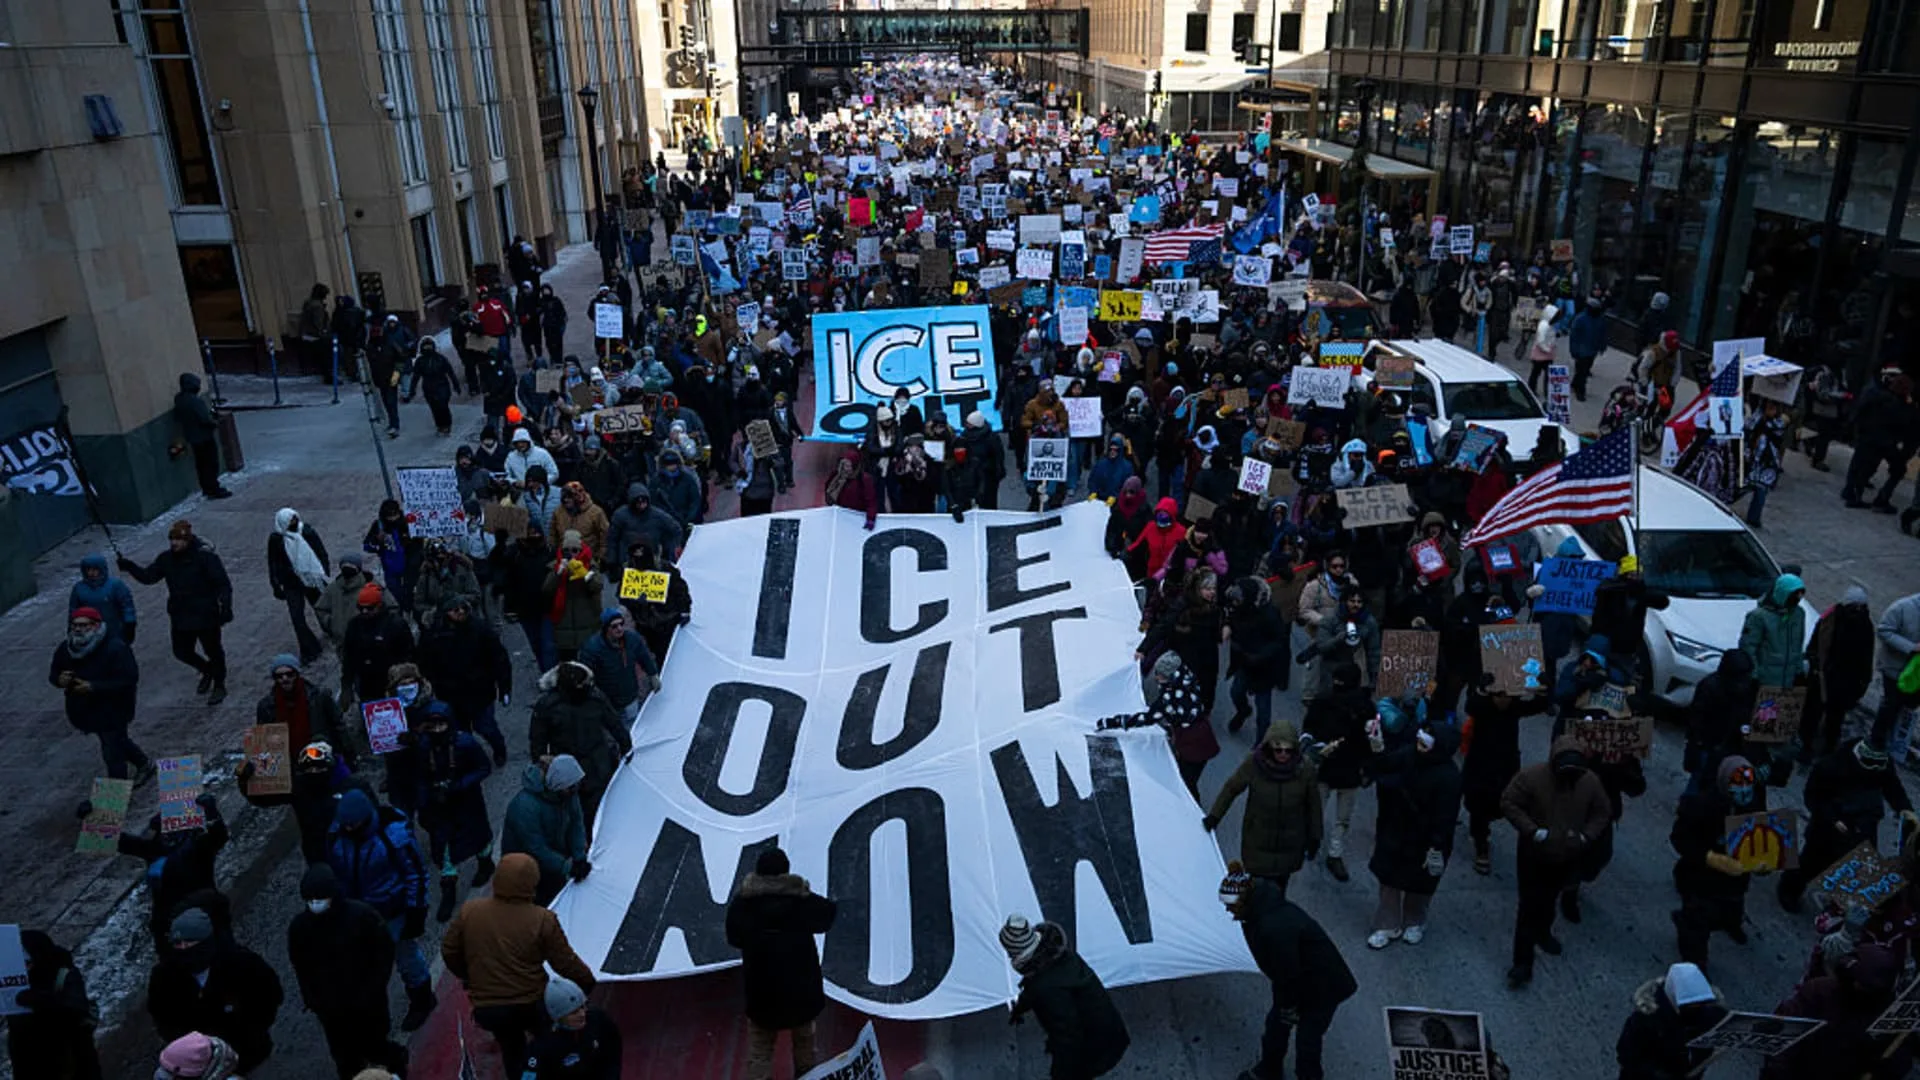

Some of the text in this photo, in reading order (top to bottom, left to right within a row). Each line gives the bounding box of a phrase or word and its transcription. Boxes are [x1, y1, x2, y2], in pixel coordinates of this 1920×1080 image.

[827, 320, 987, 405] ICE
[602, 411, 645, 432] RESIS
[820, 392, 990, 435] OT
[1345, 488, 1394, 505] ICE
[751, 515, 1071, 660] ICE
[1551, 560, 1609, 580] JUSTICE
[683, 606, 1086, 816] OUT
[600, 734, 1153, 1004] NOW
[1395, 1050, 1485, 1076] JUSTICE
